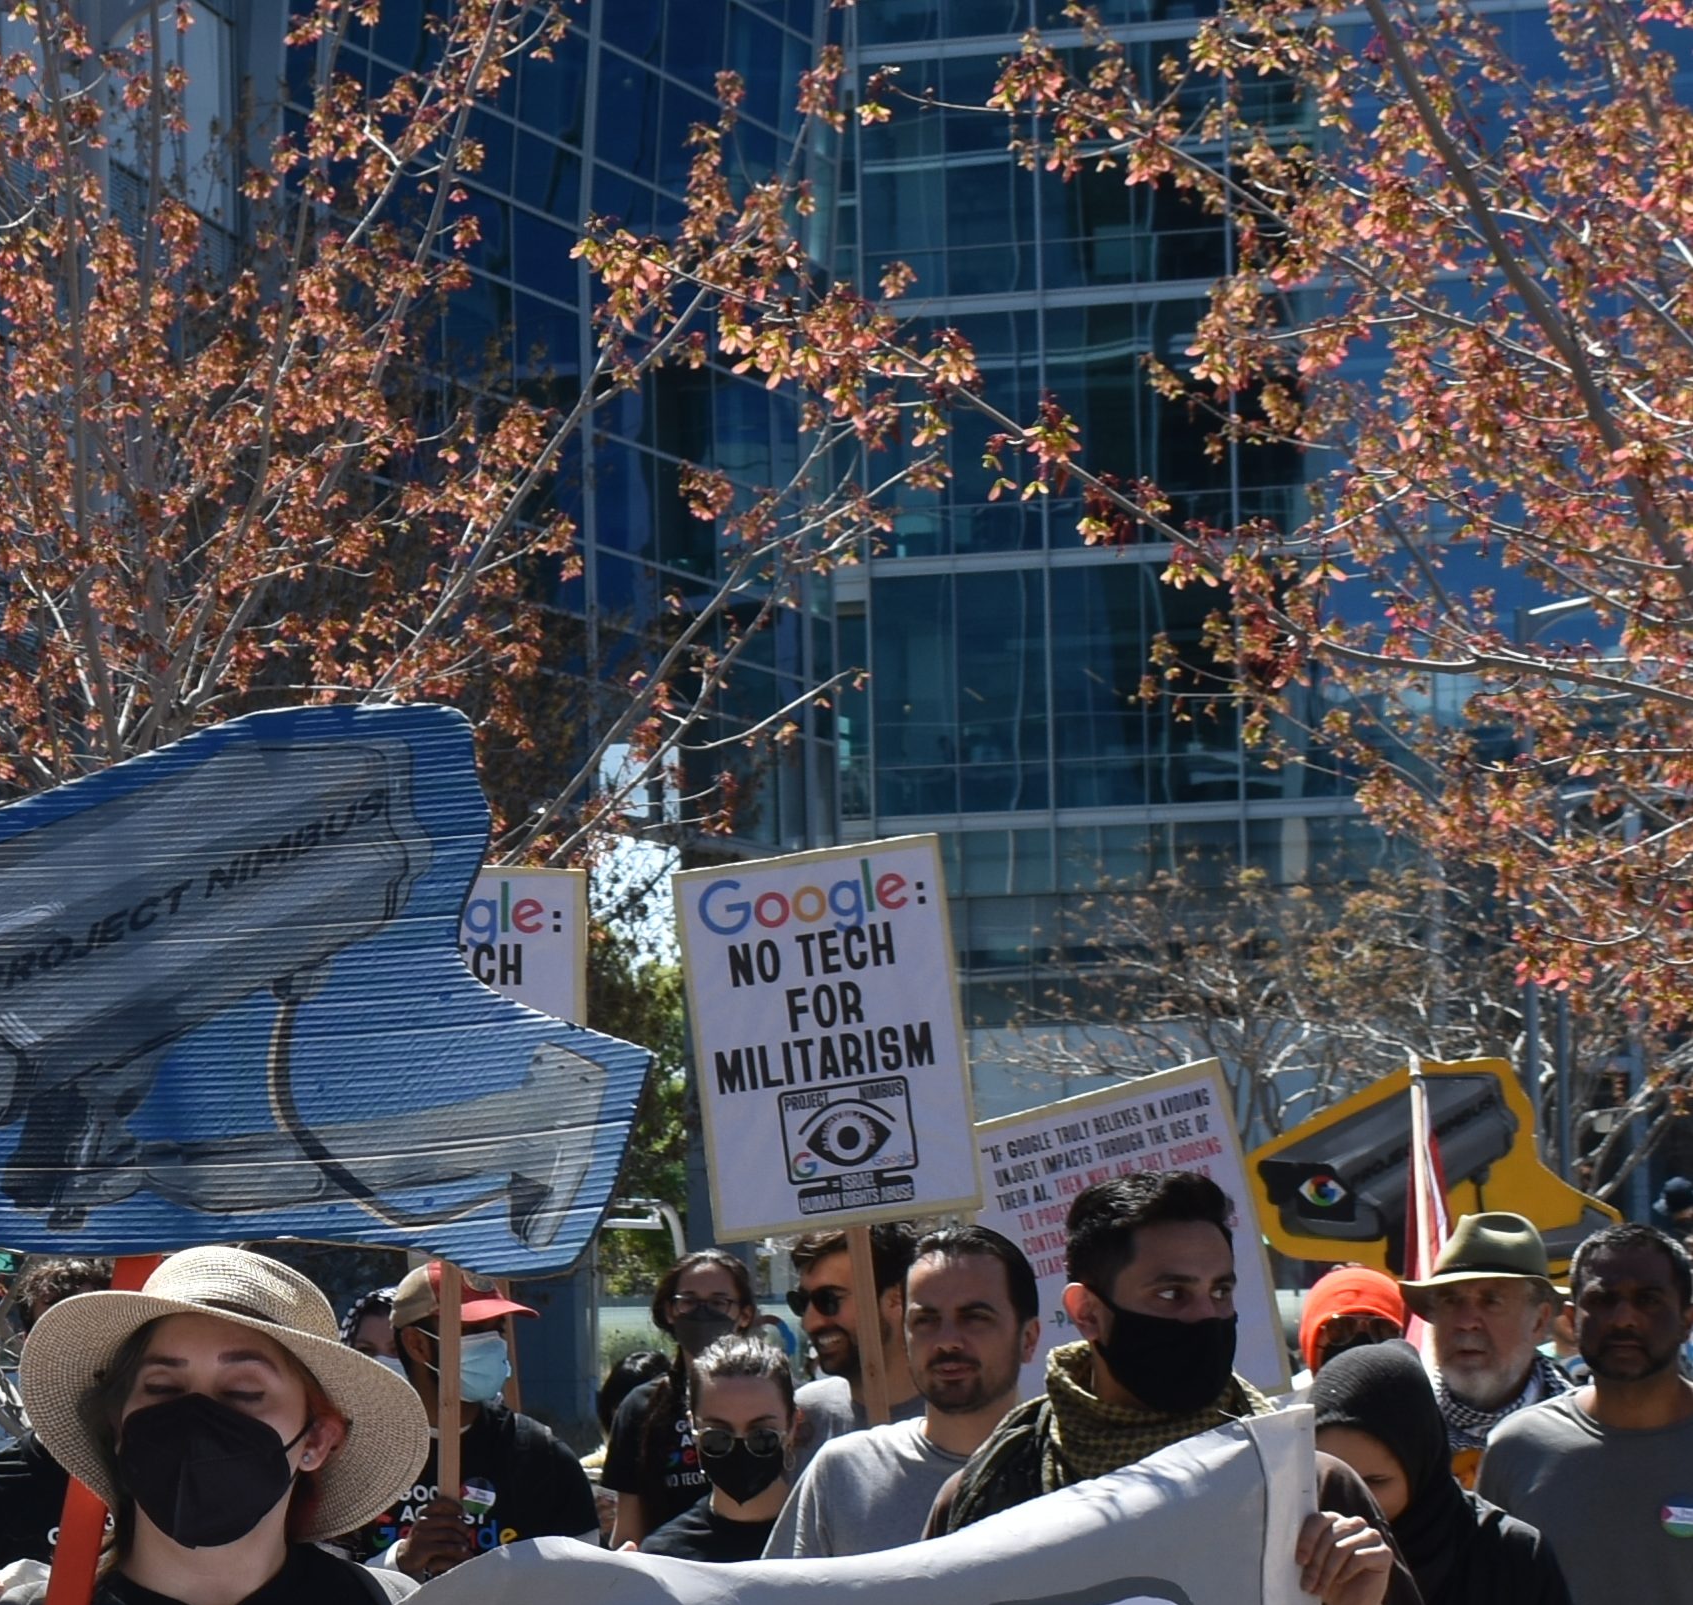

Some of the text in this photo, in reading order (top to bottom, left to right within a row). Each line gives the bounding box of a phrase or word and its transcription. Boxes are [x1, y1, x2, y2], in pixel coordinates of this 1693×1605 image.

[205, 789, 388, 900] NIMBUS
[463, 881, 562, 949] gle:
[698, 857, 928, 936] Google:
[461, 943, 522, 985] CH
[727, 921, 896, 988] NO TECH
[785, 980, 864, 1033] FOR
[714, 1021, 936, 1096] MILITARISM
[784, 1080, 904, 1112] PROJECT NIMBUS
[993, 1159, 1041, 1188] UNJUST
[1041, 1146, 1093, 1176] IMPACTS
[1146, 1124, 1169, 1146] THE
[1169, 1118, 1193, 1140] USE
[1194, 1113, 1210, 1133] OF
[1006, 1131, 1053, 1159] GOOGLE
[1054, 1119, 1091, 1146] TRULY
[1092, 1106, 1143, 1136] BELIEVES
[1143, 1102, 1158, 1122] IN
[995, 1187, 1029, 1213] THEIR
